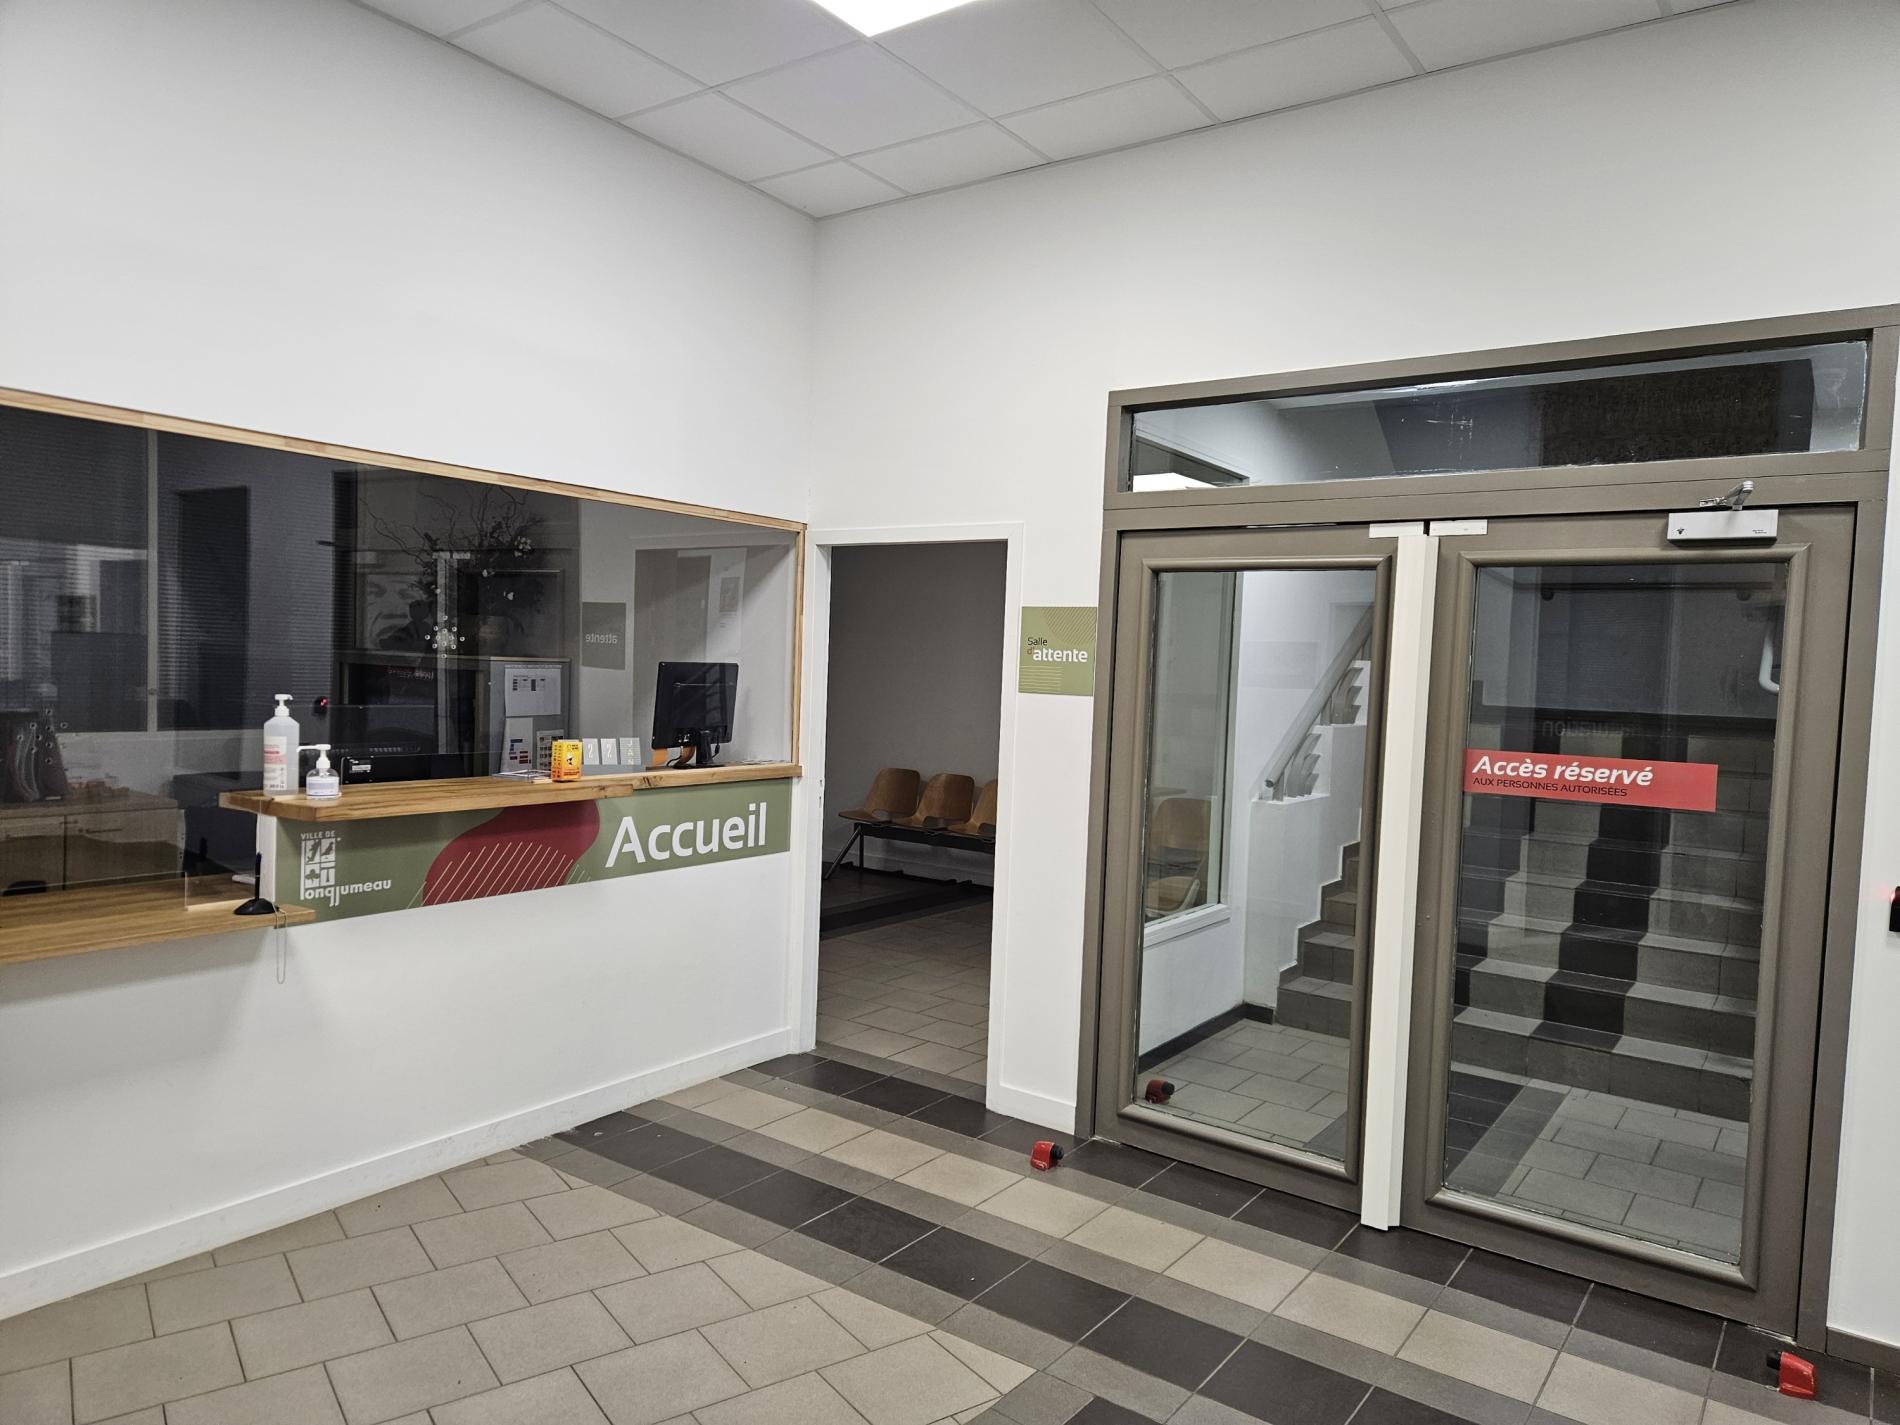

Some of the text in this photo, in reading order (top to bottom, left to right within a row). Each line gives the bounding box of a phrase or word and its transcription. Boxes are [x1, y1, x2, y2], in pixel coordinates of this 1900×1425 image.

[1027, 637, 1048, 646] Salle
[1471, 755, 1654, 786] Accès réservé
[1472, 777, 1494, 787] AUX
[1496, 779, 1558, 792] PERSONNES
[300, 830, 336, 840] VILLE DE
[605, 802, 767, 868] Accueil
